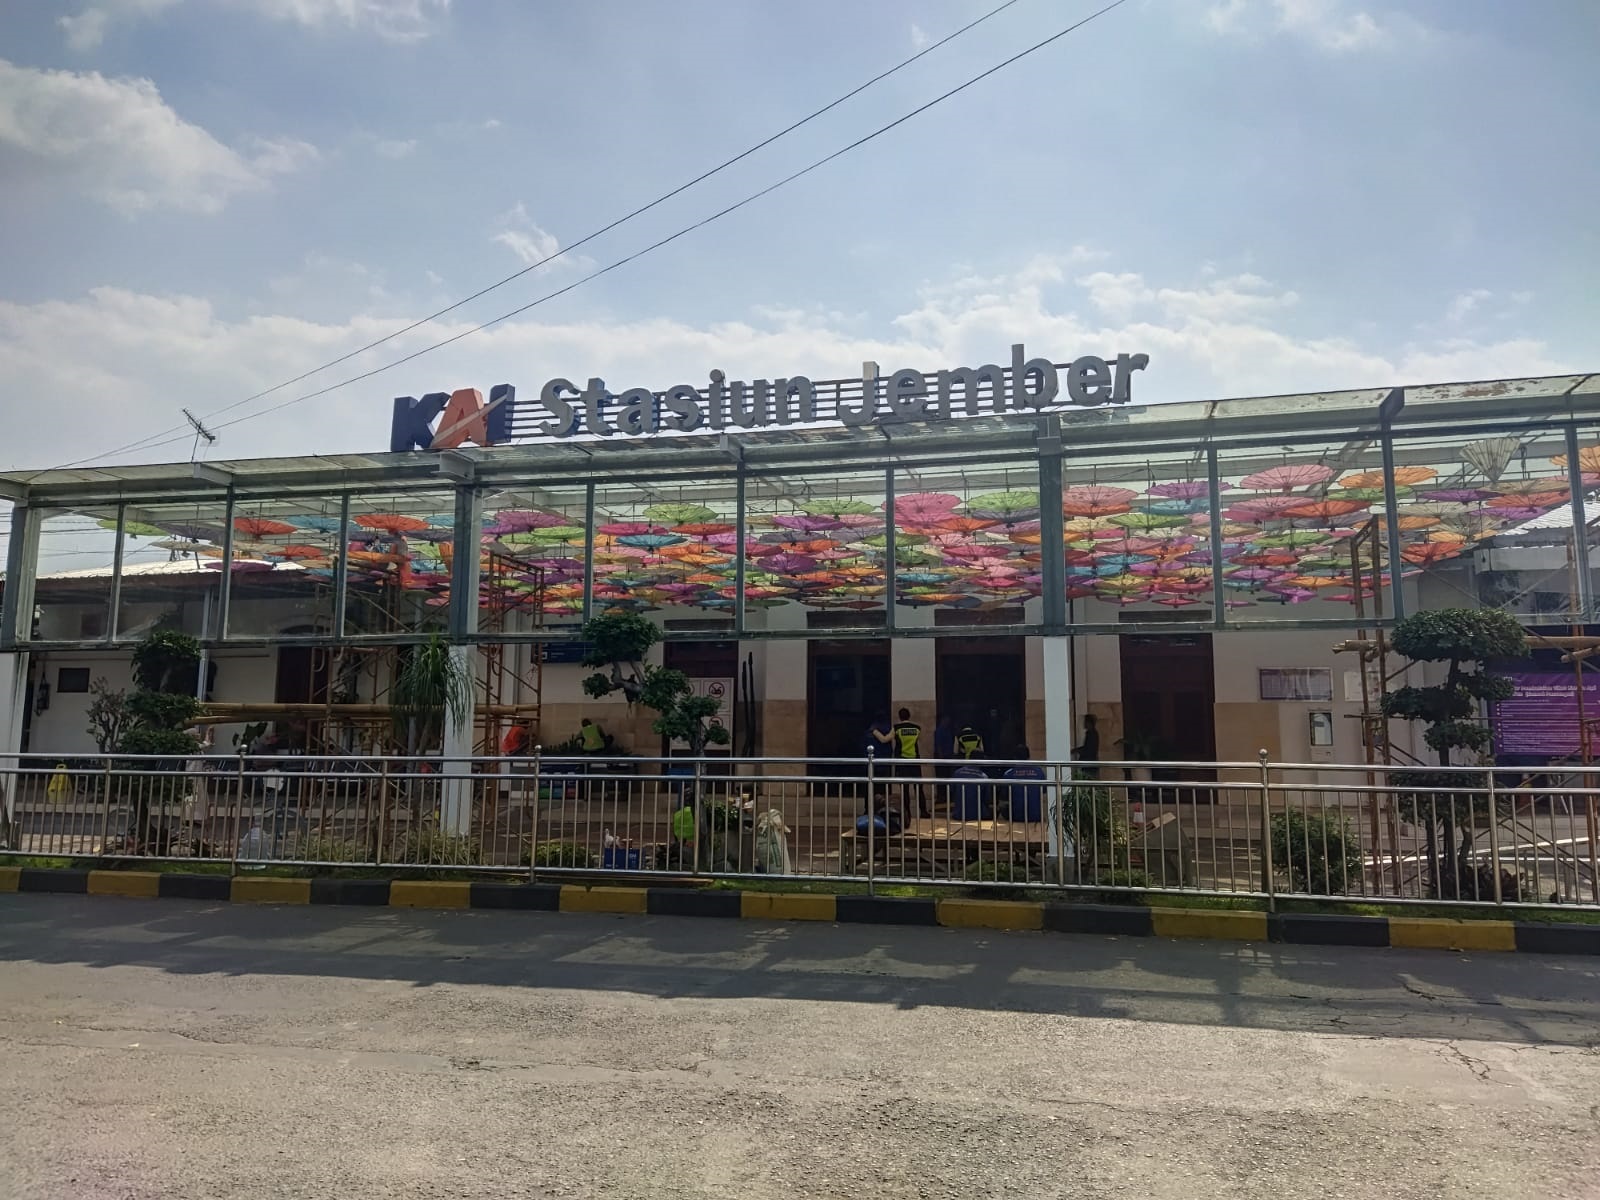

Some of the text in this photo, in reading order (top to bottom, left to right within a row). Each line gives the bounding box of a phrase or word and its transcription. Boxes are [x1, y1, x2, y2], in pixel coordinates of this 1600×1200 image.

[390, 344, 1149, 452] KAI Stasiun Jember
